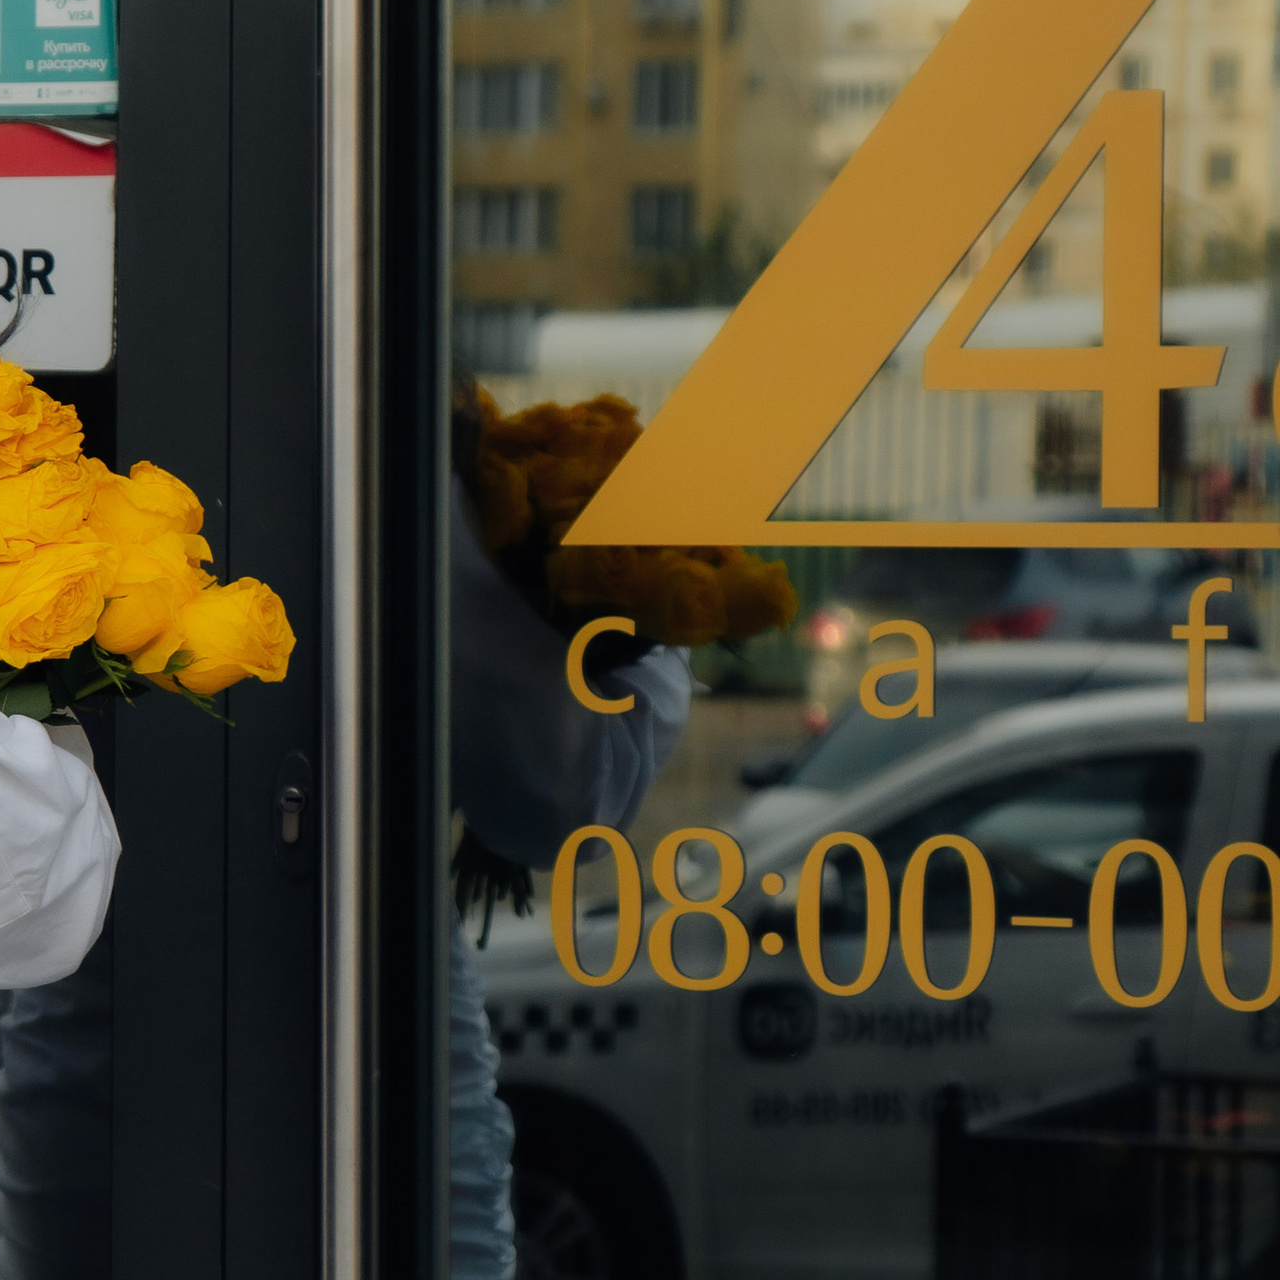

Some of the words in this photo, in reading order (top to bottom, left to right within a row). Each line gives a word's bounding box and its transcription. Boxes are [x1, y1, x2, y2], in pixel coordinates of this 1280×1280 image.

[67, 9, 95, 21] VISA
[44, 40, 91, 55] Купить
[37, 57, 109, 74] рассрочку
